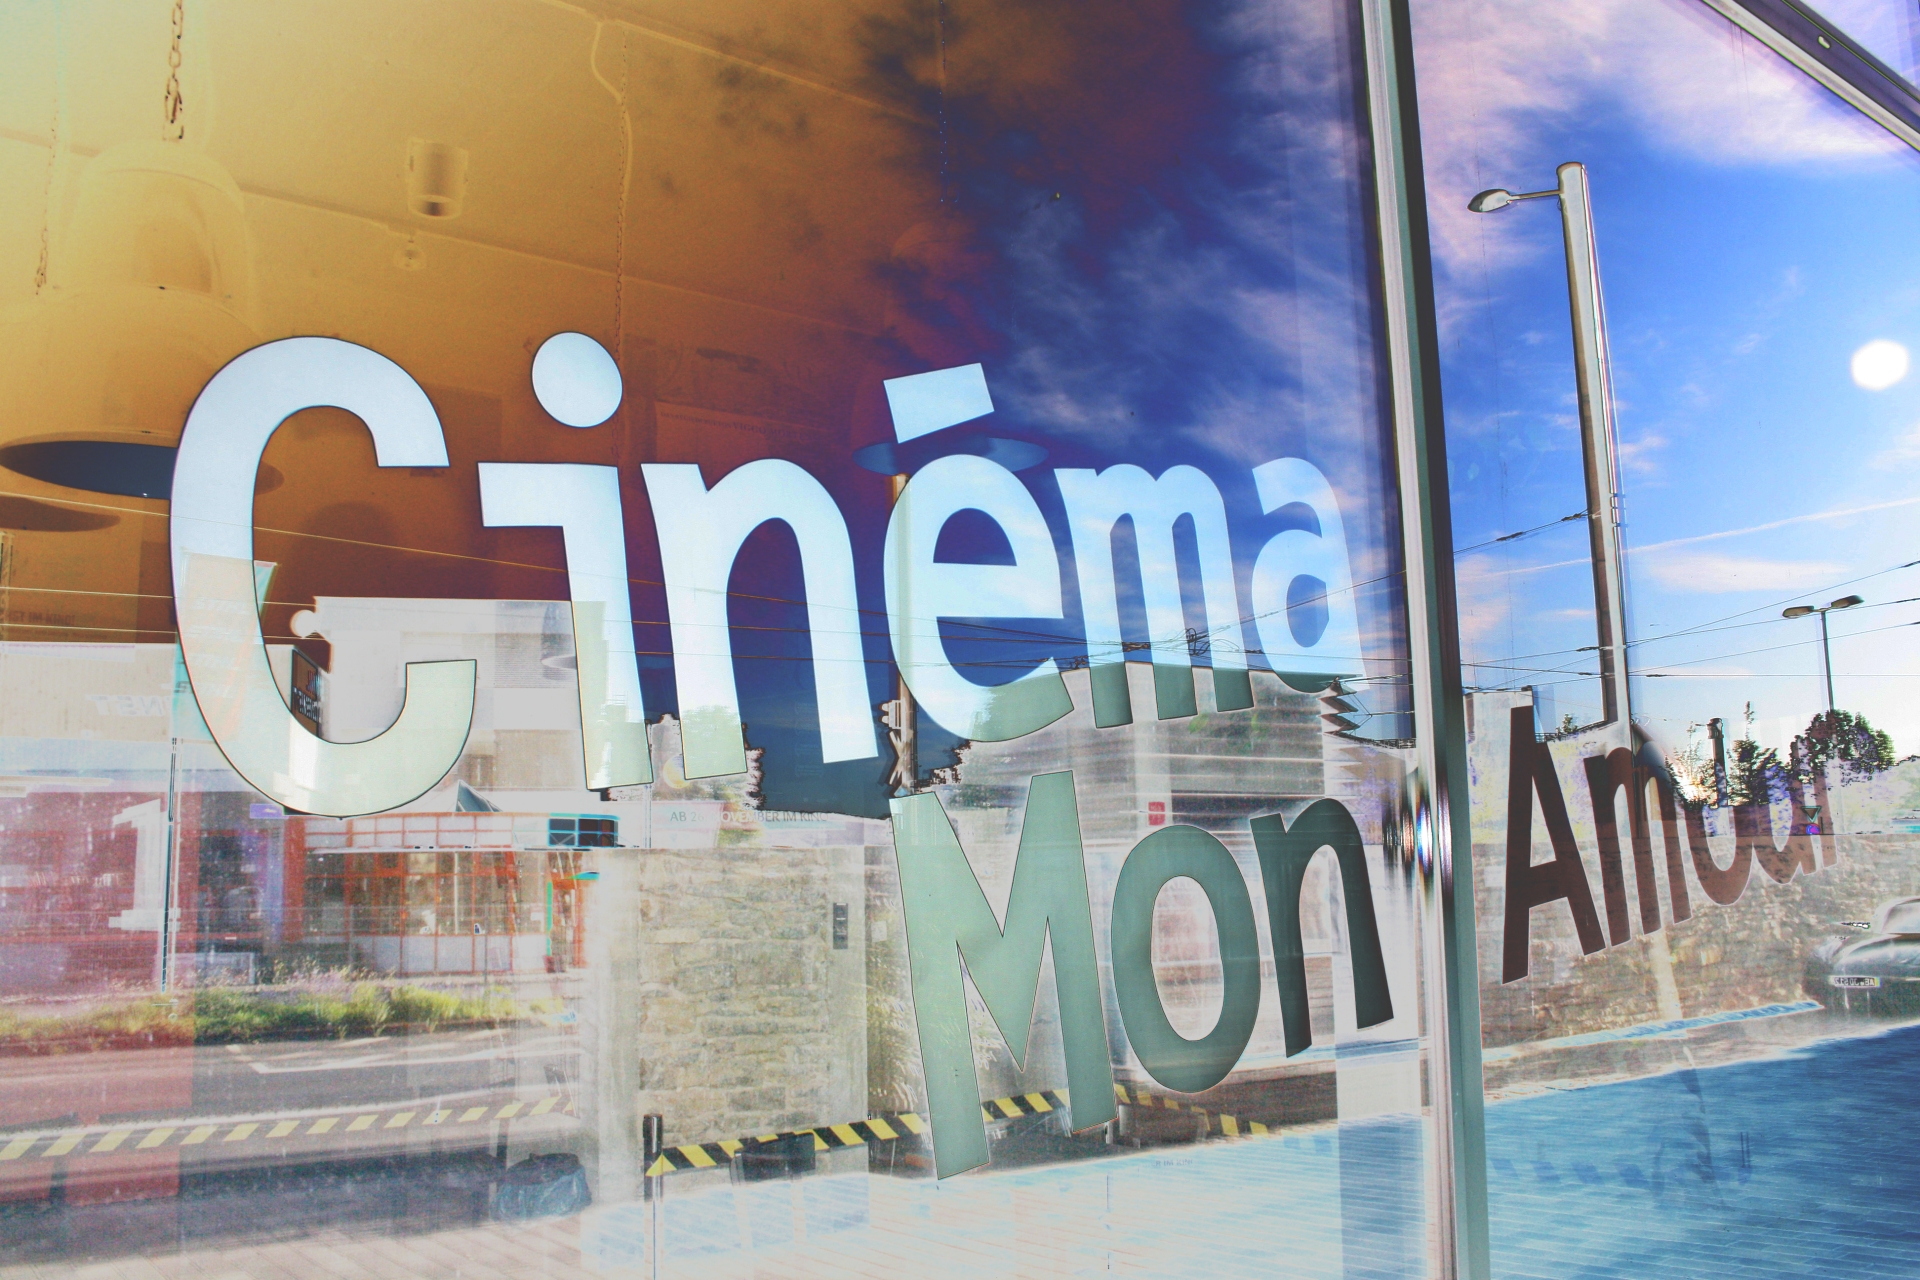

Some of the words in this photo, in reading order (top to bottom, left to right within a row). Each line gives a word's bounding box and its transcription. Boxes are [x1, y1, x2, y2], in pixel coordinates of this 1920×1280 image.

[170, 335, 1371, 816] Cinéma
[670, 811, 687, 822] AB
[783, 811, 797, 823] IM
[801, 811, 829, 823] KINO
[889, 770, 1395, 1180] Mon
[1502, 705, 1838, 984] Amour
